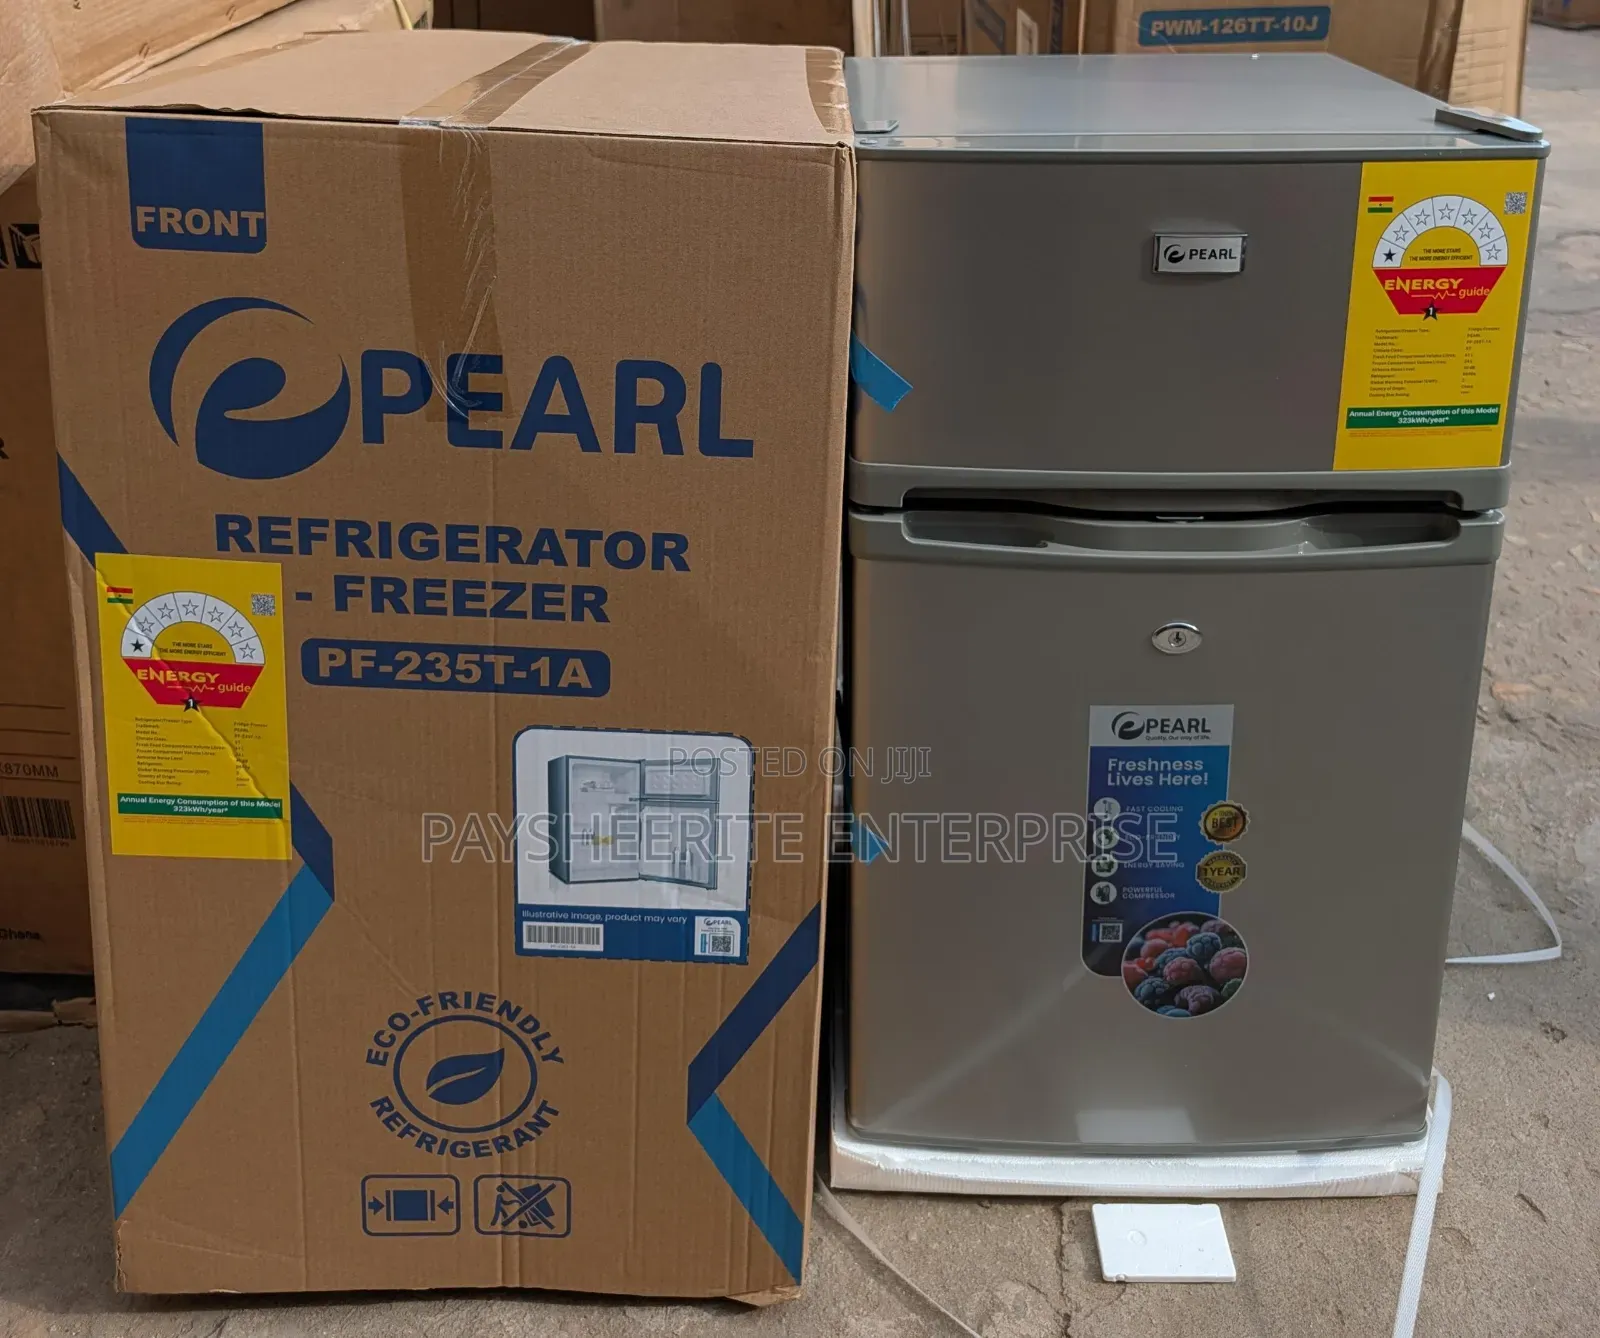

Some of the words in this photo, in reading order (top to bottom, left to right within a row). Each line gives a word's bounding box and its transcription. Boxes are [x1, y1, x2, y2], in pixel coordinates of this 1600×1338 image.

[1151, 15, 1319, 37] PWM-126TT-10J
[136, 206, 265, 237] FRONT
[1189, 248, 1237, 260] PEARL
[1384, 276, 1464, 294] ENERGY
[1459, 287, 1490, 299] guide
[1428, 307, 1434, 316] 1
[361, 349, 753, 458] PEARL
[1349, 410, 1375, 418] Annual
[1376, 410, 1401, 419] Energy
[1402, 408, 1451, 418] Consumption
[1460, 407, 1475, 415] this
[215, 514, 691, 572] REFRIGERATOR
[334, 574, 610, 623] FREEZER
[318, 647, 592, 689] PF-235T-1A
[137, 666, 220, 685] ENERGY
[218, 683, 251, 694] guide
[188, 699, 194, 708] 1
[1146, 718, 1211, 734] PEARL
[1107, 757, 1204, 772] Freshness
[1107, 772, 1154, 786] Lives
[1158, 772, 1209, 786] Here!
[120, 795, 147, 803] Annual
[148, 796, 176, 806] Energy
[177, 797, 229, 807] Consumption
[230, 799, 239, 807] of
[239, 800, 255, 808] this
[256, 800, 281, 808] Model
[1126, 805, 1146, 813] FAST
[1147, 805, 1184, 813] COOLING
[1211, 816, 1237, 829] BEST
[1123, 861, 1154, 869] ENERGY
[1155, 861, 1185, 869] SAVING
[1202, 867, 1208, 877] 1
[1209, 866, 1241, 877] YEAR
[1122, 886, 1163, 894] POWERFUL
[1122, 892, 1176, 900] COMPRESSOR
[522, 910, 569, 919] Illustrative
[605, 913, 642, 923] product
[644, 915, 666, 925] may
[667, 916, 688, 925] vary
[366, 991, 564, 1067] ECO-FRIENDLY
[370, 1096, 559, 1158] REFRIGERANT
